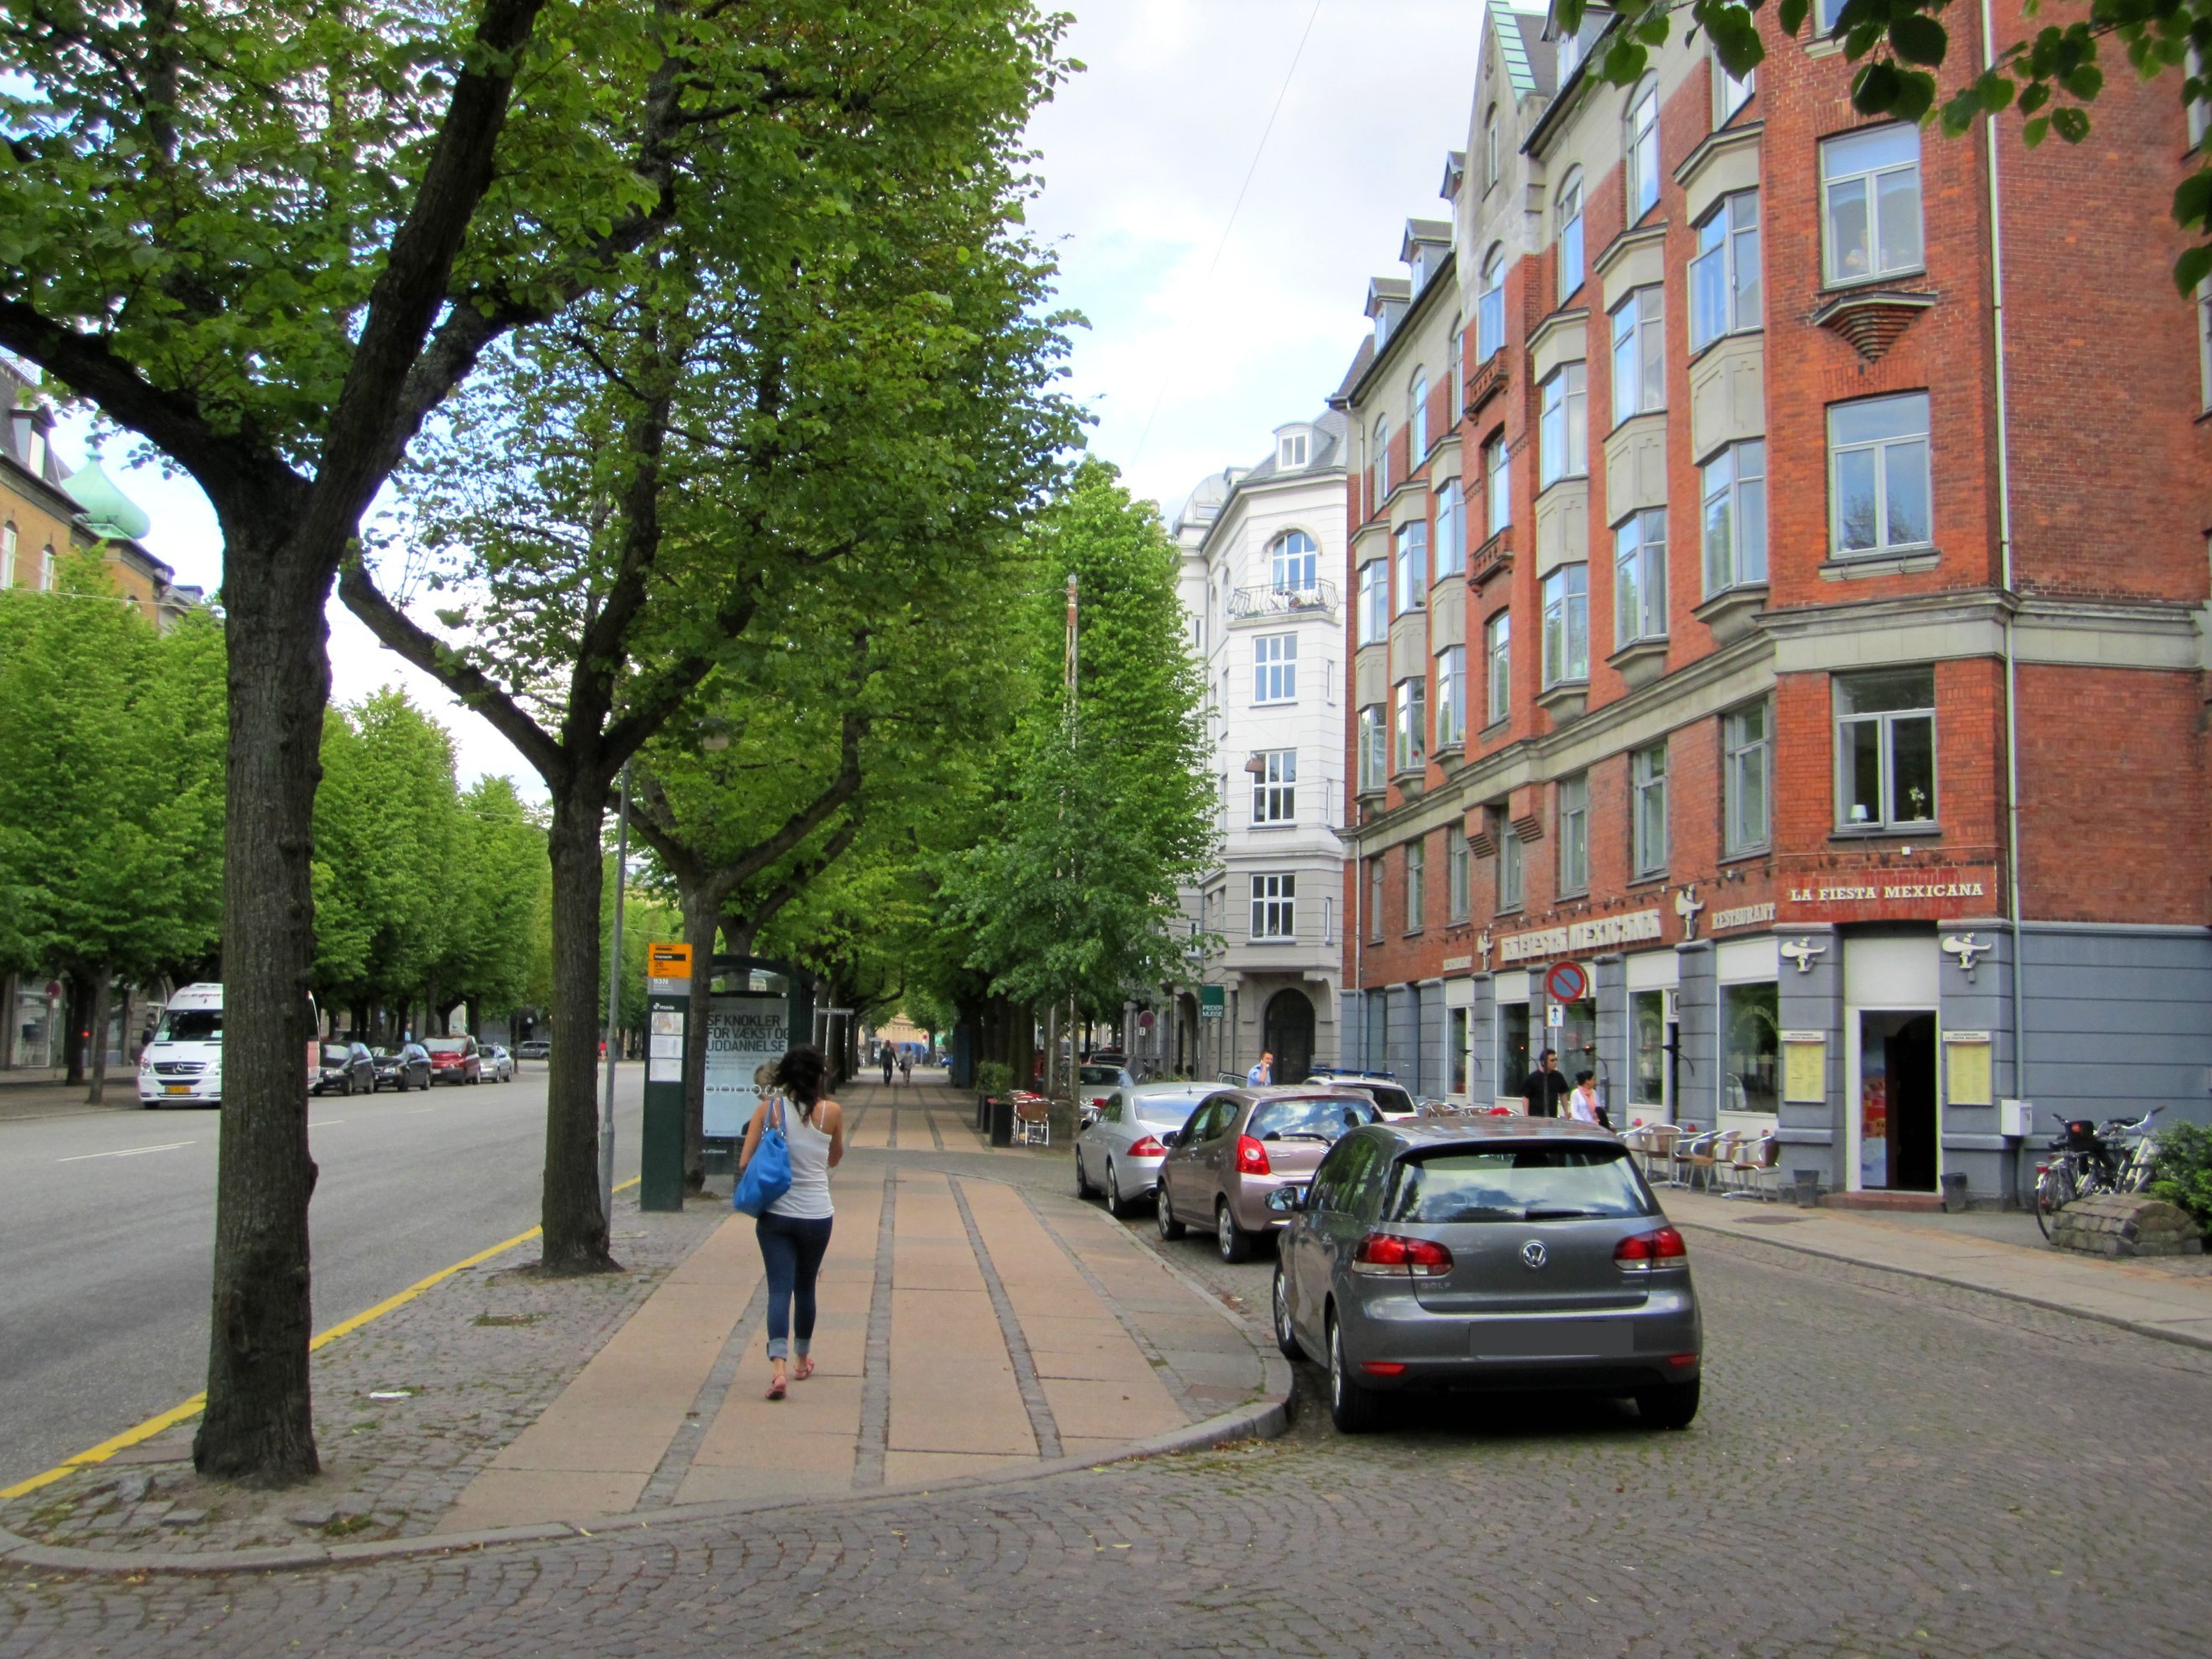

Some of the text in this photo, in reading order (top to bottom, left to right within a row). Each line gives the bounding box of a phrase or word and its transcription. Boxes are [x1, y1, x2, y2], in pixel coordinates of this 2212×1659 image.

[1791, 883, 1984, 902] LA FIESTA MEXICANA
[1712, 902, 1775, 929] RESTAURANT
[1569, 908, 1662, 950] MEXICANA
[707, 1014, 781, 1027] SF KNOKLER
[706, 1027, 730, 1039] FOR
[731, 1027, 773, 1039] VÆKST
[706, 1040, 785, 1052] UDDANNELSE
